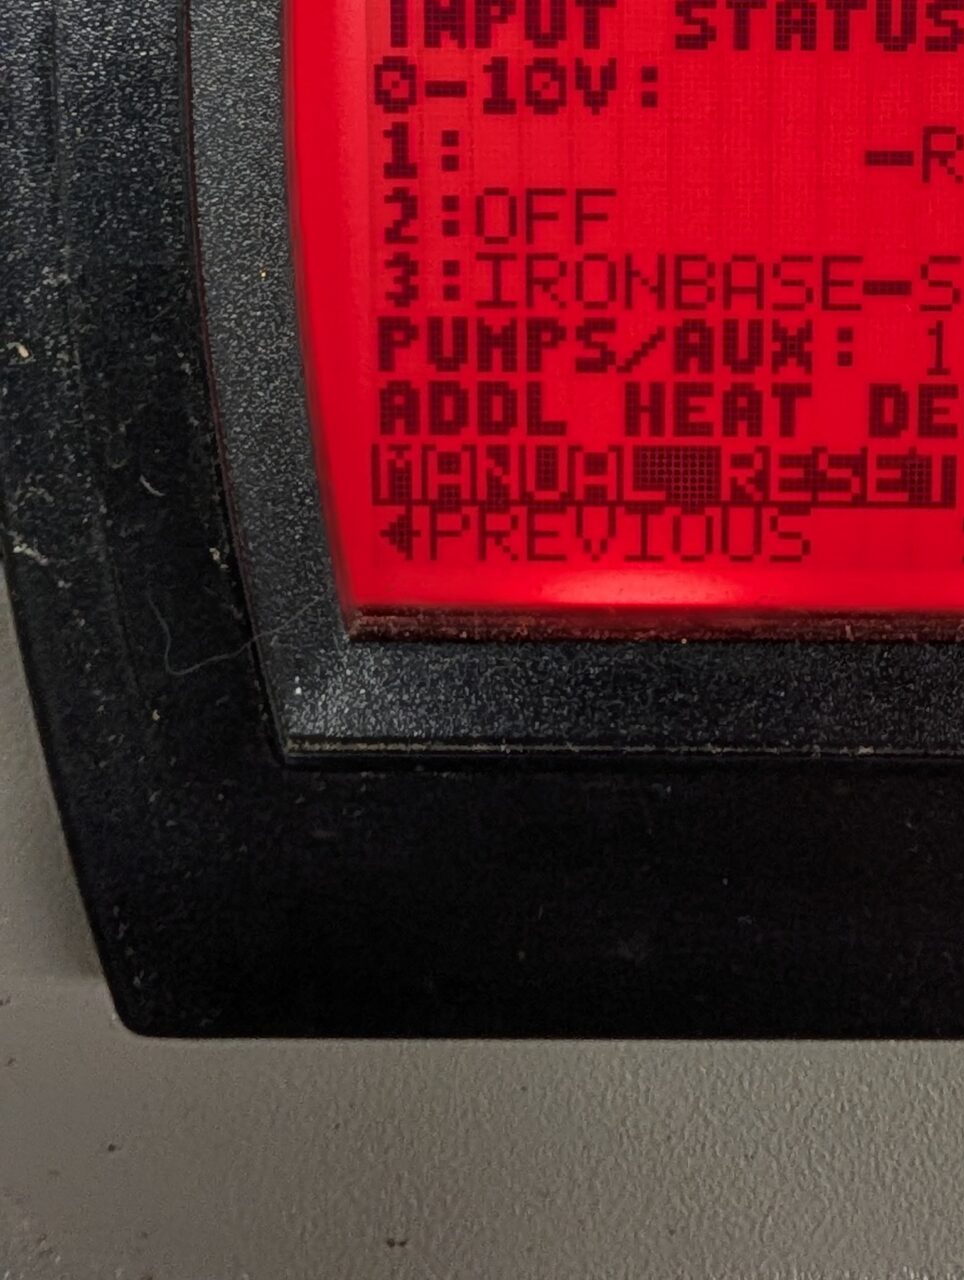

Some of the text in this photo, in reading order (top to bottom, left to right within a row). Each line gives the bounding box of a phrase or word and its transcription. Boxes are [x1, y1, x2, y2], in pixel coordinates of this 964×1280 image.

[374, 56, 658, 115] 0-10V:
[384, 121, 459, 179] 1:
[378, 316, 854, 374] PUMPS/AUX:
[927, 321, 951, 376] 1
[379, 380, 567, 436] ADDL
[624, 381, 812, 437] HEAT
[374, 444, 956, 508] MANUAL RESET
[430, 505, 811, 562] PREVIOUS
